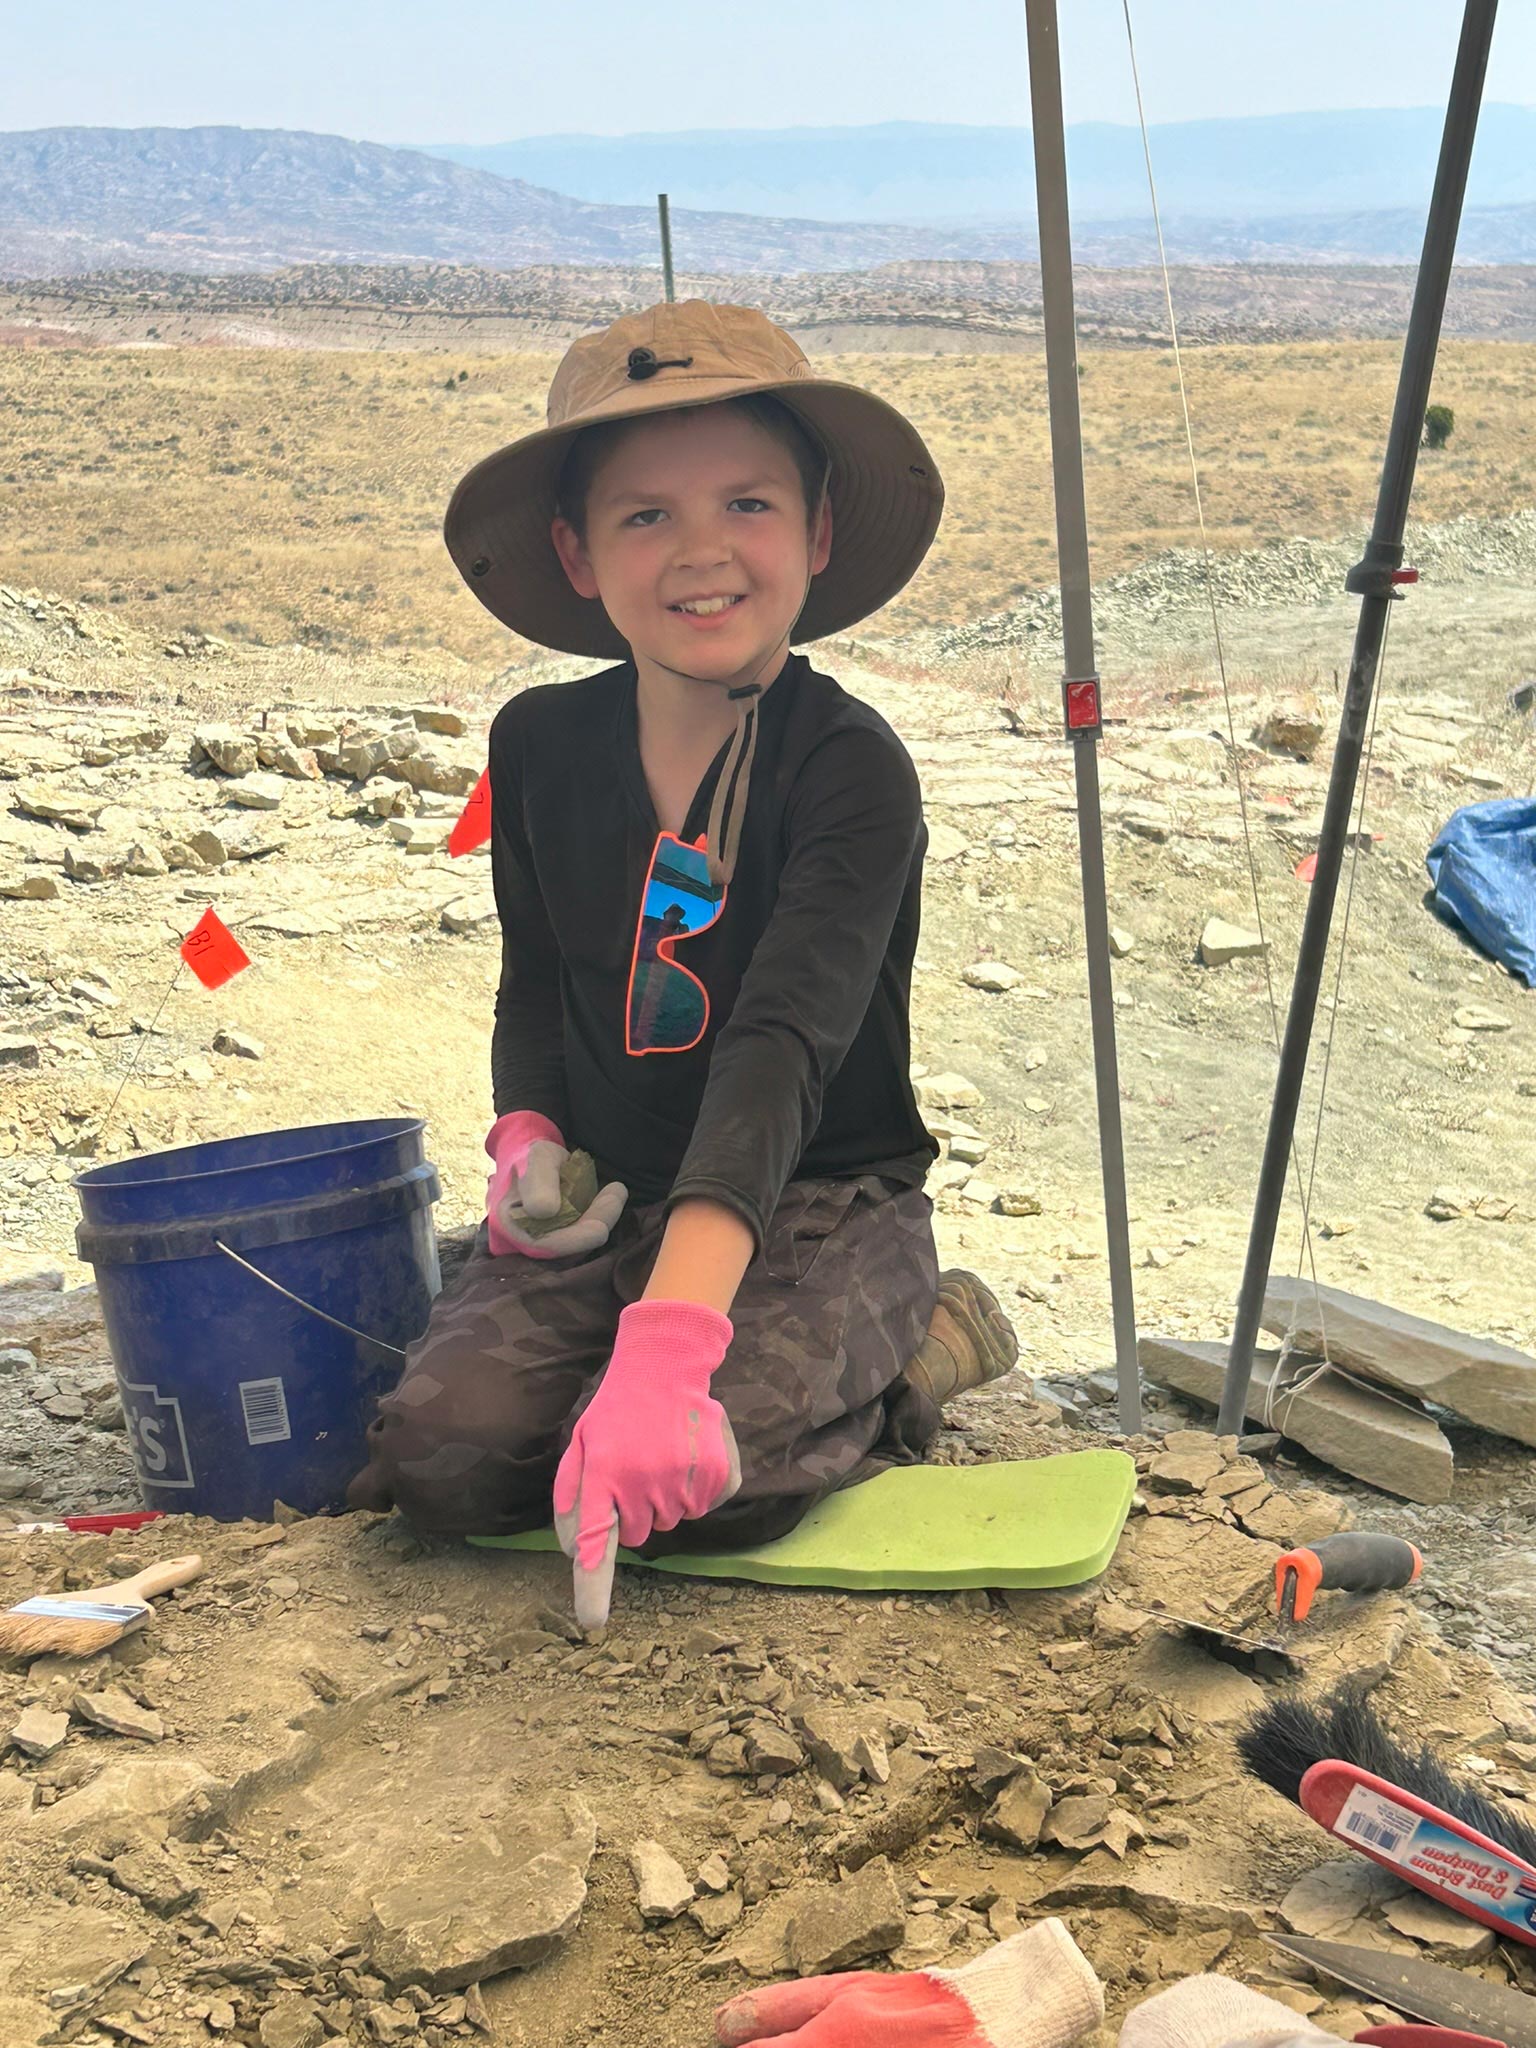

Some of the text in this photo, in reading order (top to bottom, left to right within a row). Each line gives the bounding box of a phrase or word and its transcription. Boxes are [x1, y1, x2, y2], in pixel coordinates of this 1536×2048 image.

[1409, 1855, 1508, 1901] Dust Broom
[1421, 1847, 1509, 1884] & Dustpan
